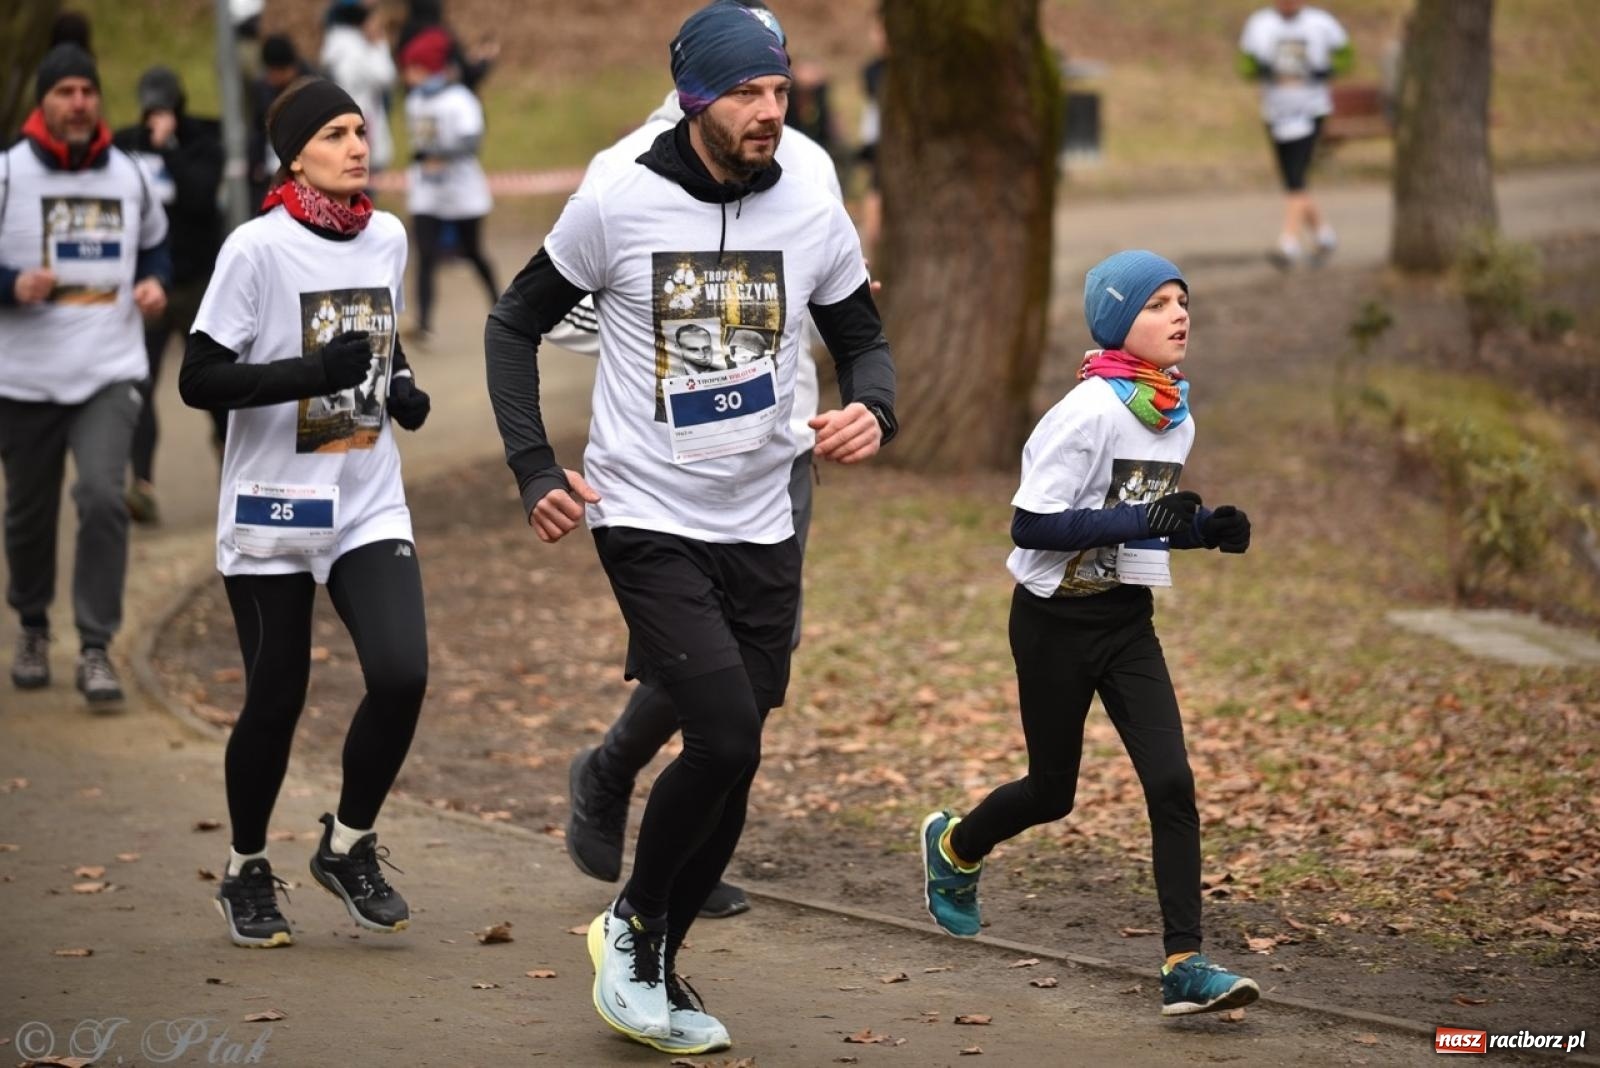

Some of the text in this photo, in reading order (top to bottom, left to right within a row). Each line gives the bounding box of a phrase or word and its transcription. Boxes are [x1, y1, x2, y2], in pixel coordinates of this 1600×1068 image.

[704, 270, 741, 281] TROPEM
[705, 283, 779, 300] WILCZYM
[714, 391, 742, 412] 30
[270, 502, 294, 521] 25
